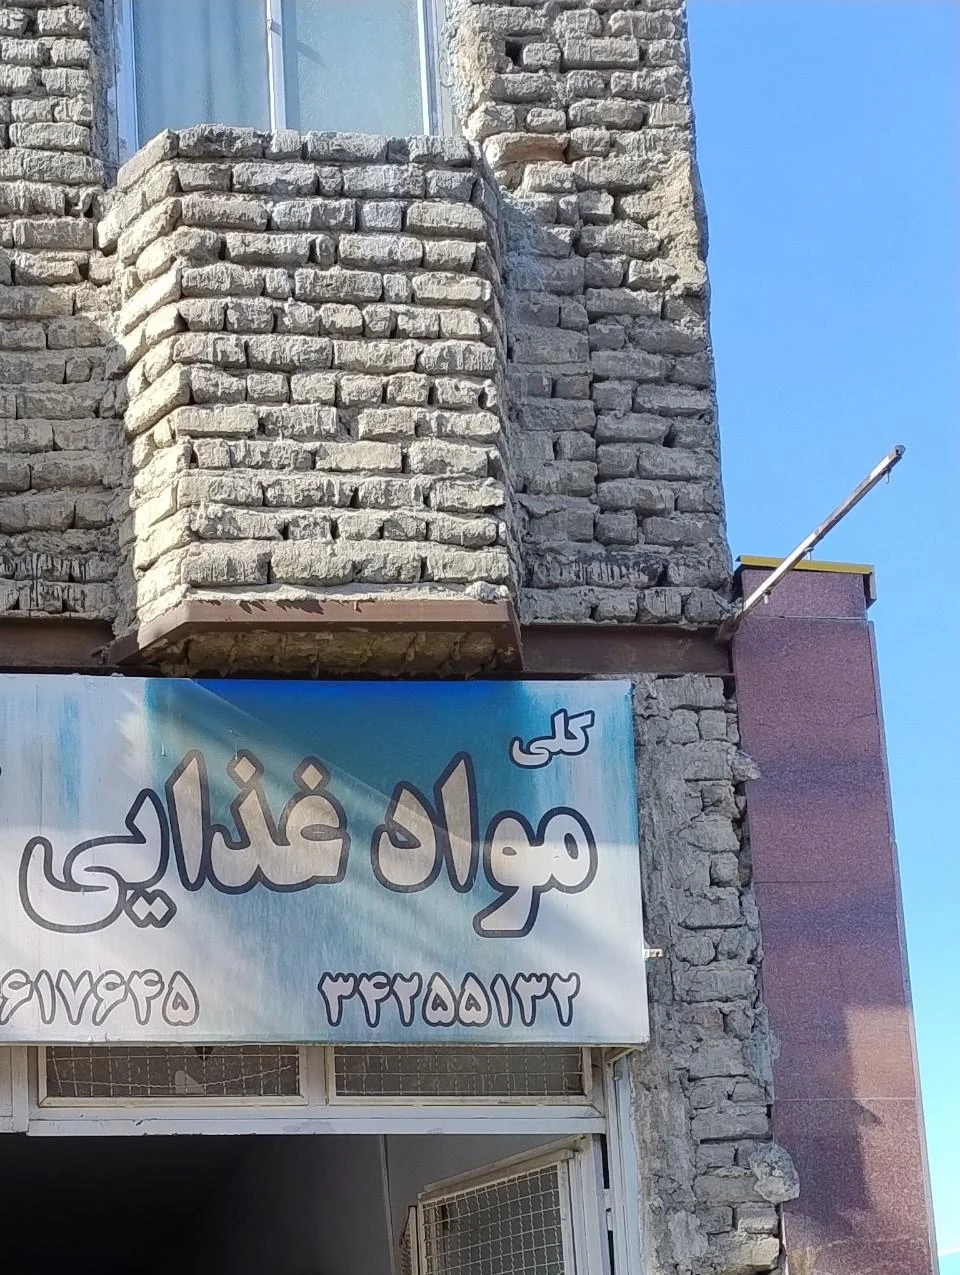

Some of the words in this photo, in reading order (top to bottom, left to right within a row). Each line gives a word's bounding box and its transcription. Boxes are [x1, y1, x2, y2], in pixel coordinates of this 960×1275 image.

[509, 708, 595, 769] کلی
[18, 748, 352, 934] غذایی
[371, 750, 599, 939] مواد
[317, 971, 581, 1029] ۳۴۲۵۵۱۳۲
